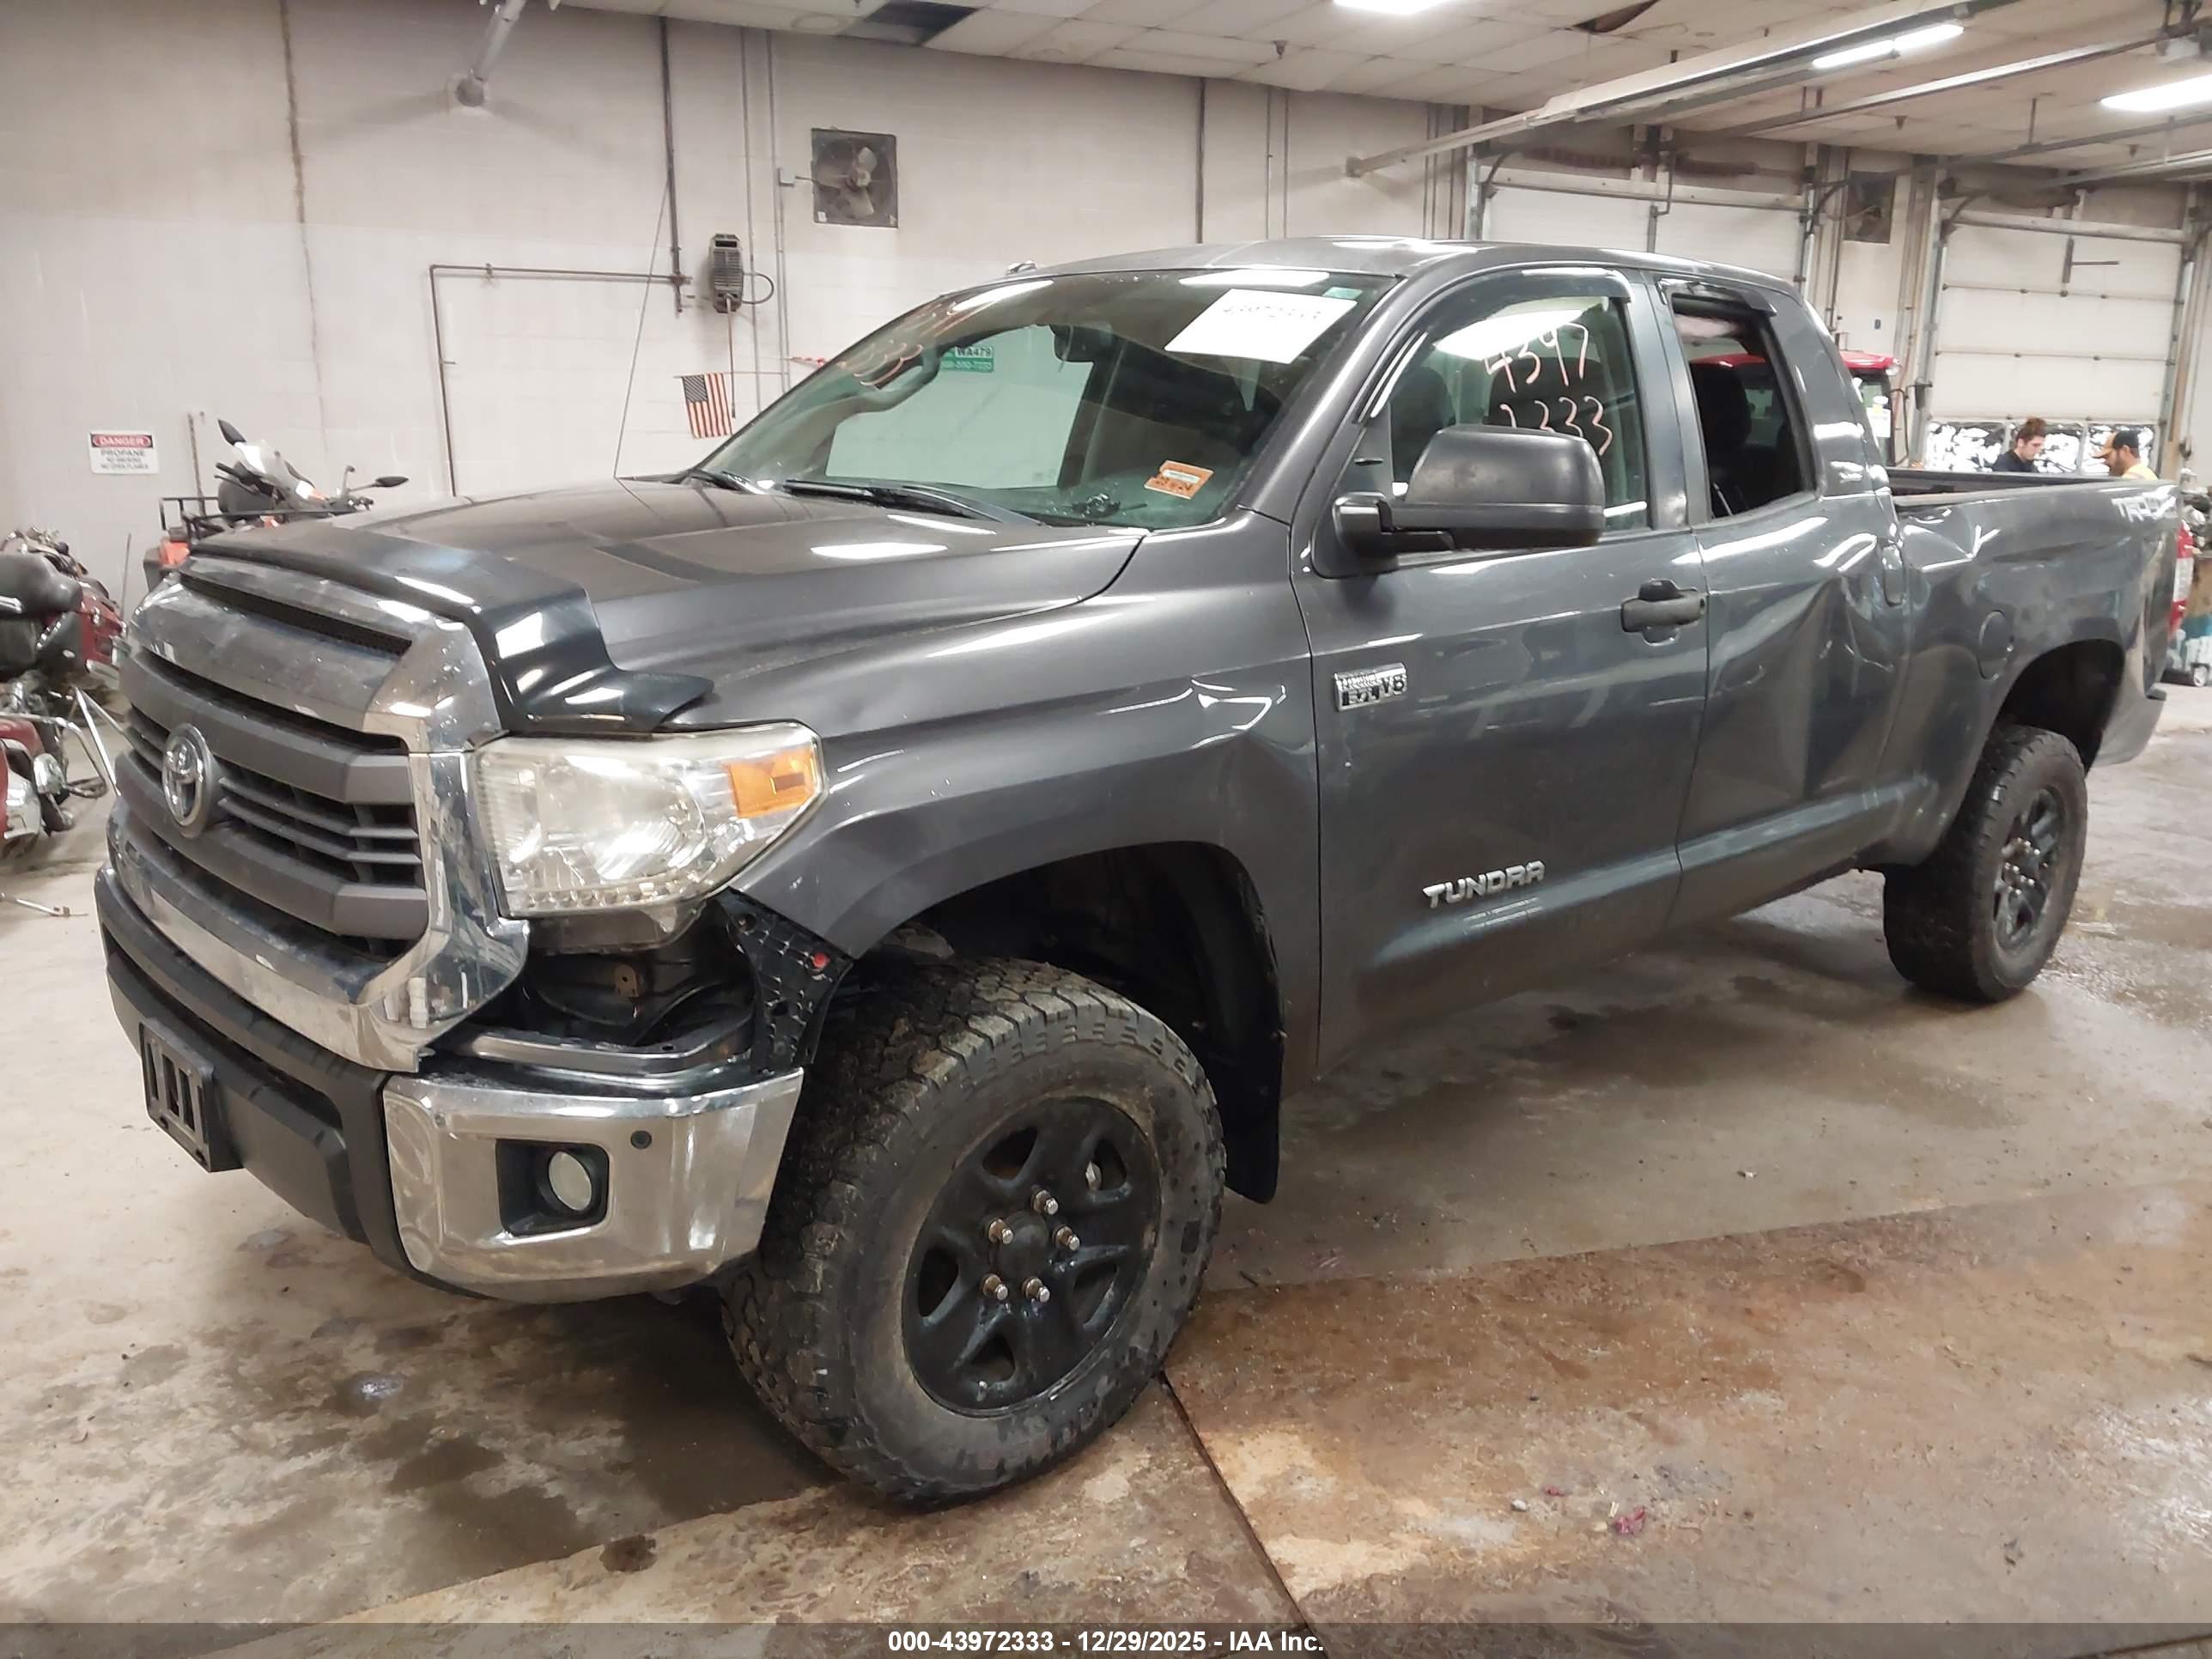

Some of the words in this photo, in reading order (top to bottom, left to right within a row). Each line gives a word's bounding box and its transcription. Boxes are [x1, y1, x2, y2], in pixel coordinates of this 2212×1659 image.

[99, 435, 144, 447] DANGER
[100, 449, 146, 458] PROPANE
[1422, 860, 1547, 909] TUNDRA
